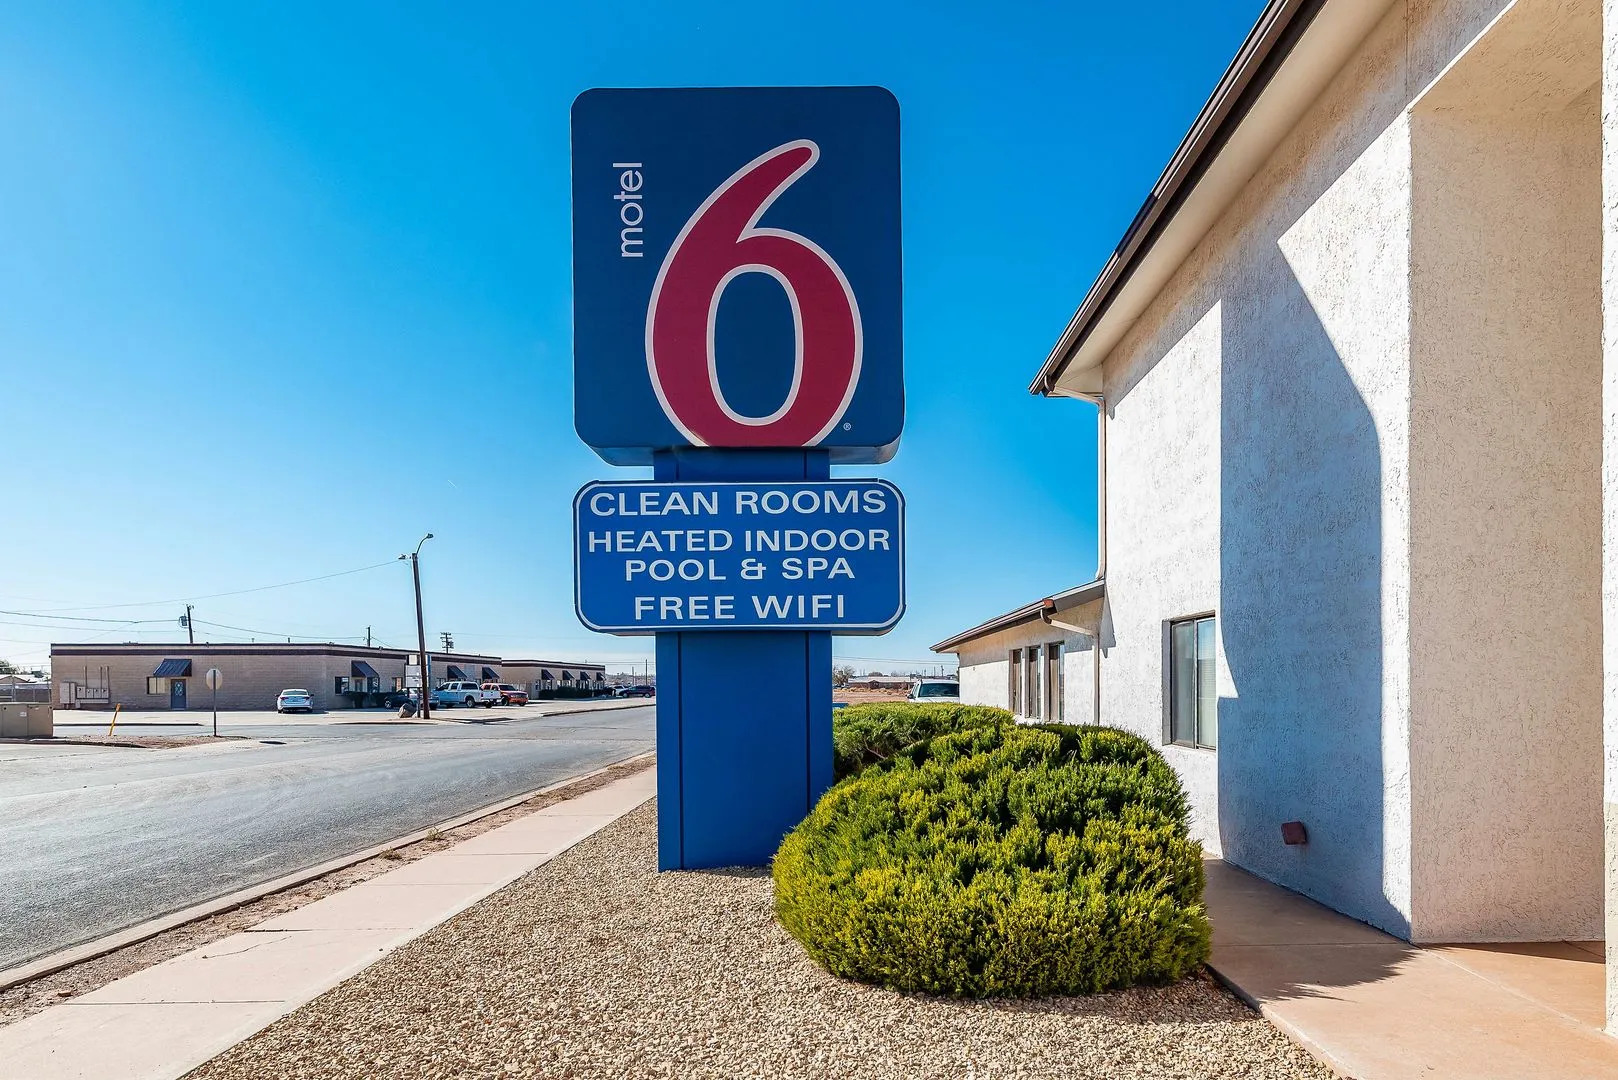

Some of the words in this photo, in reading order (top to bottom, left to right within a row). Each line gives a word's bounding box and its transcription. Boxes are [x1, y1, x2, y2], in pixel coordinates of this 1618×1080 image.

[612, 162, 643, 257] motel
[645, 139, 863, 446] 6
[590, 491, 718, 516] CLEAN
[735, 489, 887, 515] ROOMS
[588, 529, 733, 553] HEATED
[745, 529, 890, 552] INDOOR
[625, 558, 727, 581] POOL
[740, 558, 767, 580] &
[781, 557, 856, 580] SPA
[634, 595, 736, 620] FREE
[751, 594, 844, 619] WIFI
